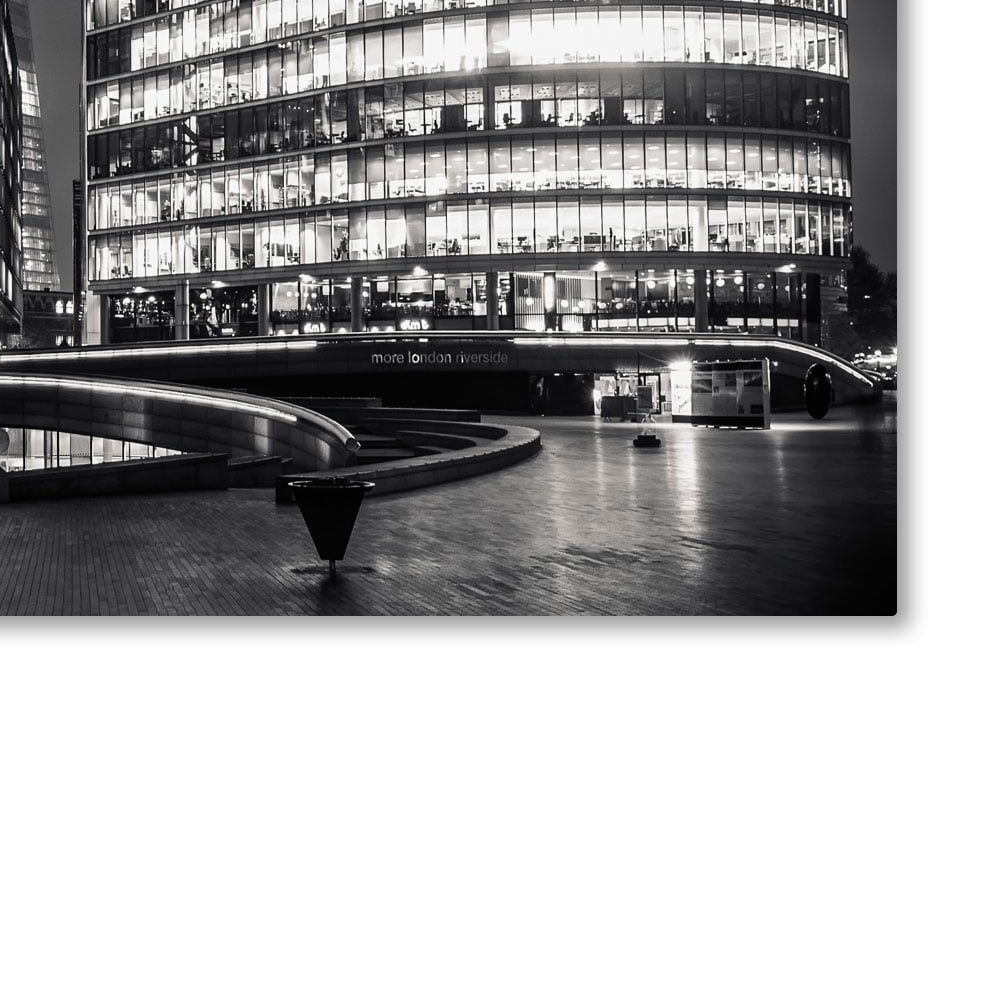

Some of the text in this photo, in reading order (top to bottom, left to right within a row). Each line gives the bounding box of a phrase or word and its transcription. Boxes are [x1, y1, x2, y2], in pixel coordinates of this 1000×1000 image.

[371, 351, 509, 364] more london riverside
